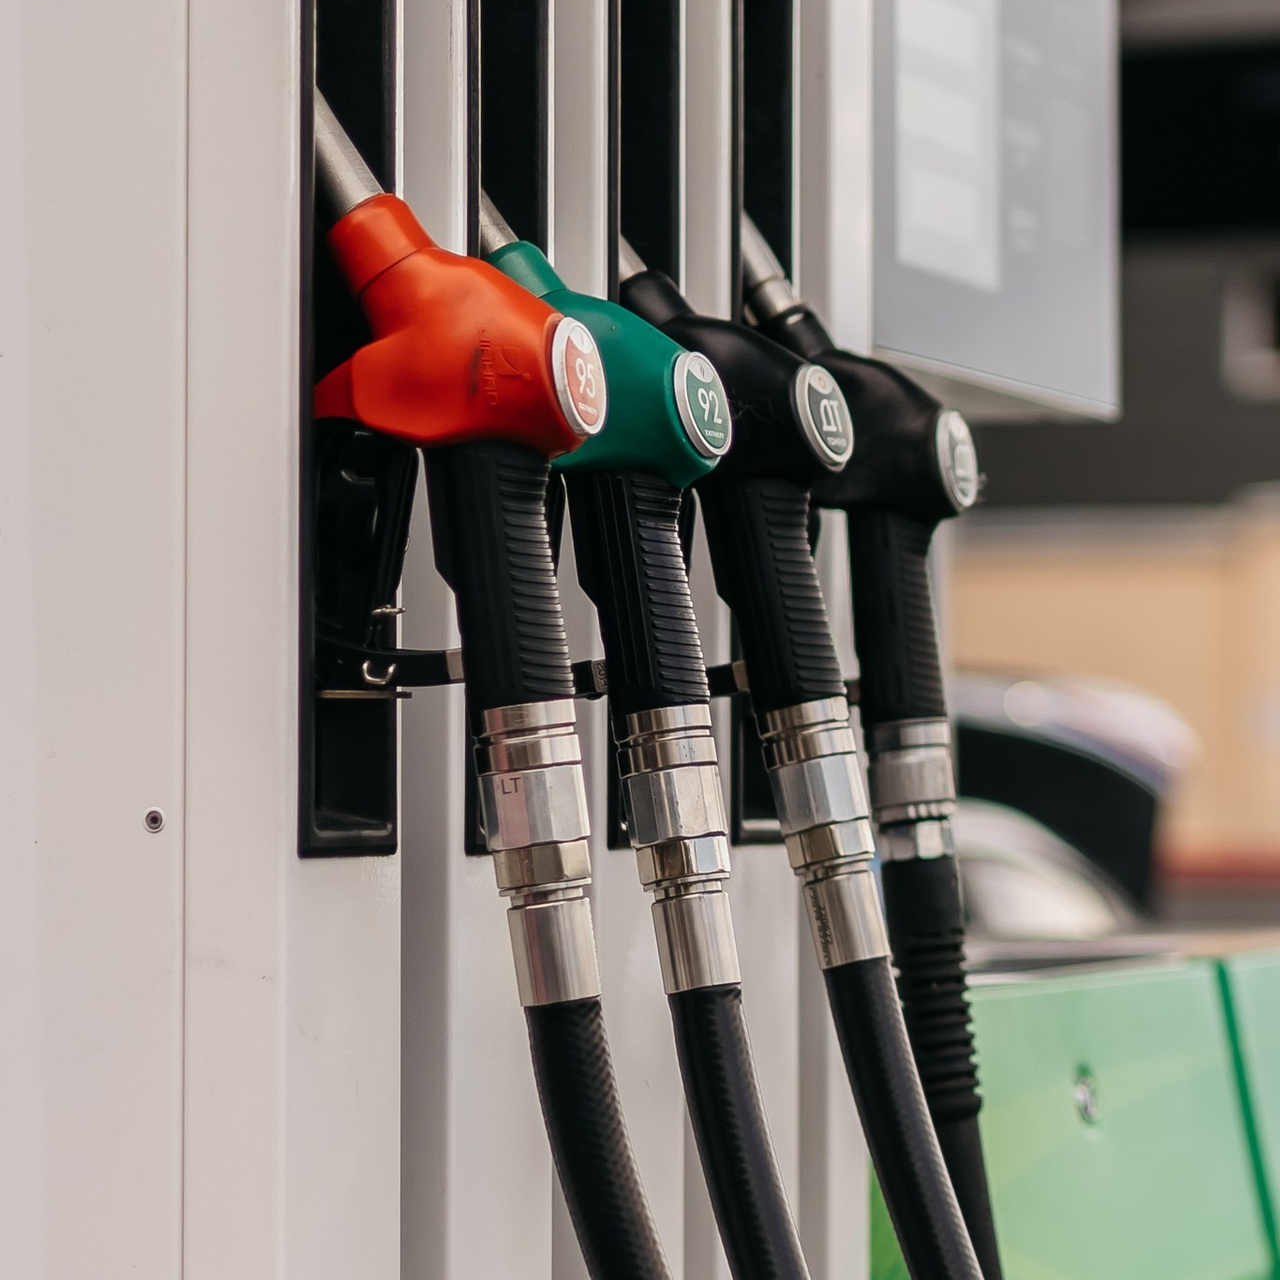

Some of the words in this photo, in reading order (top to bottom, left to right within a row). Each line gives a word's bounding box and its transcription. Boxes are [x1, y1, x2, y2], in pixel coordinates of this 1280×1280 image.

[575, 357, 596, 399] 95
[697, 387, 722, 425] 92
[820, 399, 843, 433] ДТ
[501, 777, 521, 795] LT
